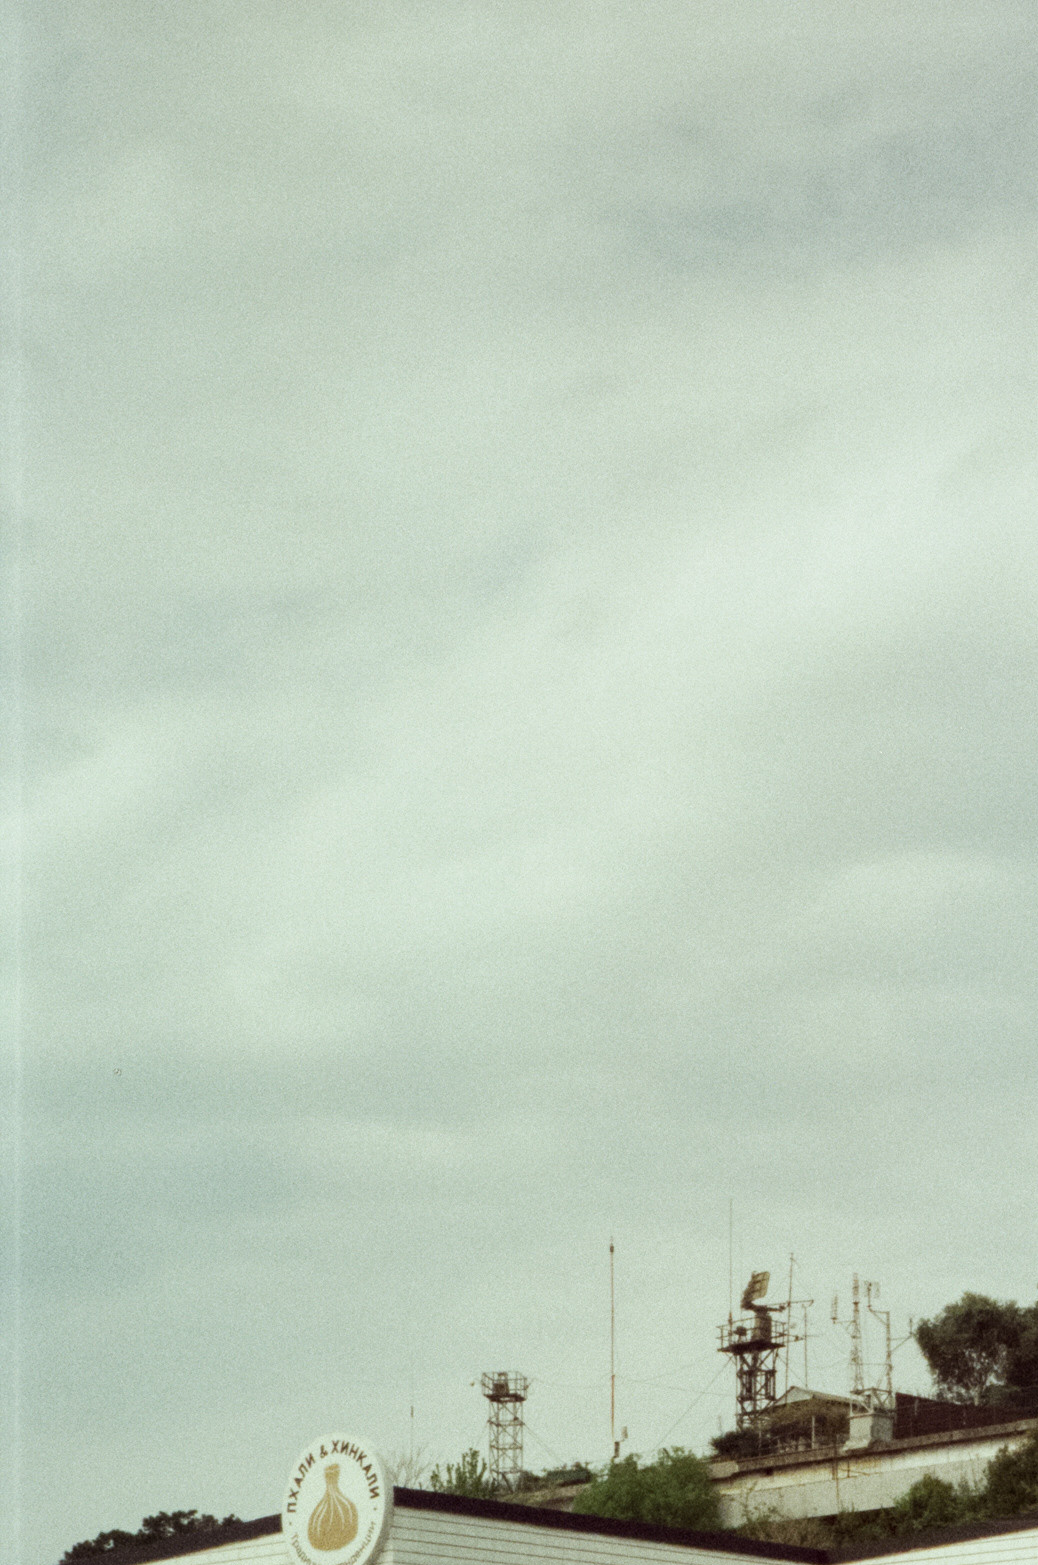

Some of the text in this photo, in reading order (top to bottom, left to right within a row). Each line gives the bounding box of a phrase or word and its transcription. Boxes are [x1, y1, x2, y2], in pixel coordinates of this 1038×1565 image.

[287, 1440, 380, 1513] ПХАЛИ & ХИНКАЛИ
